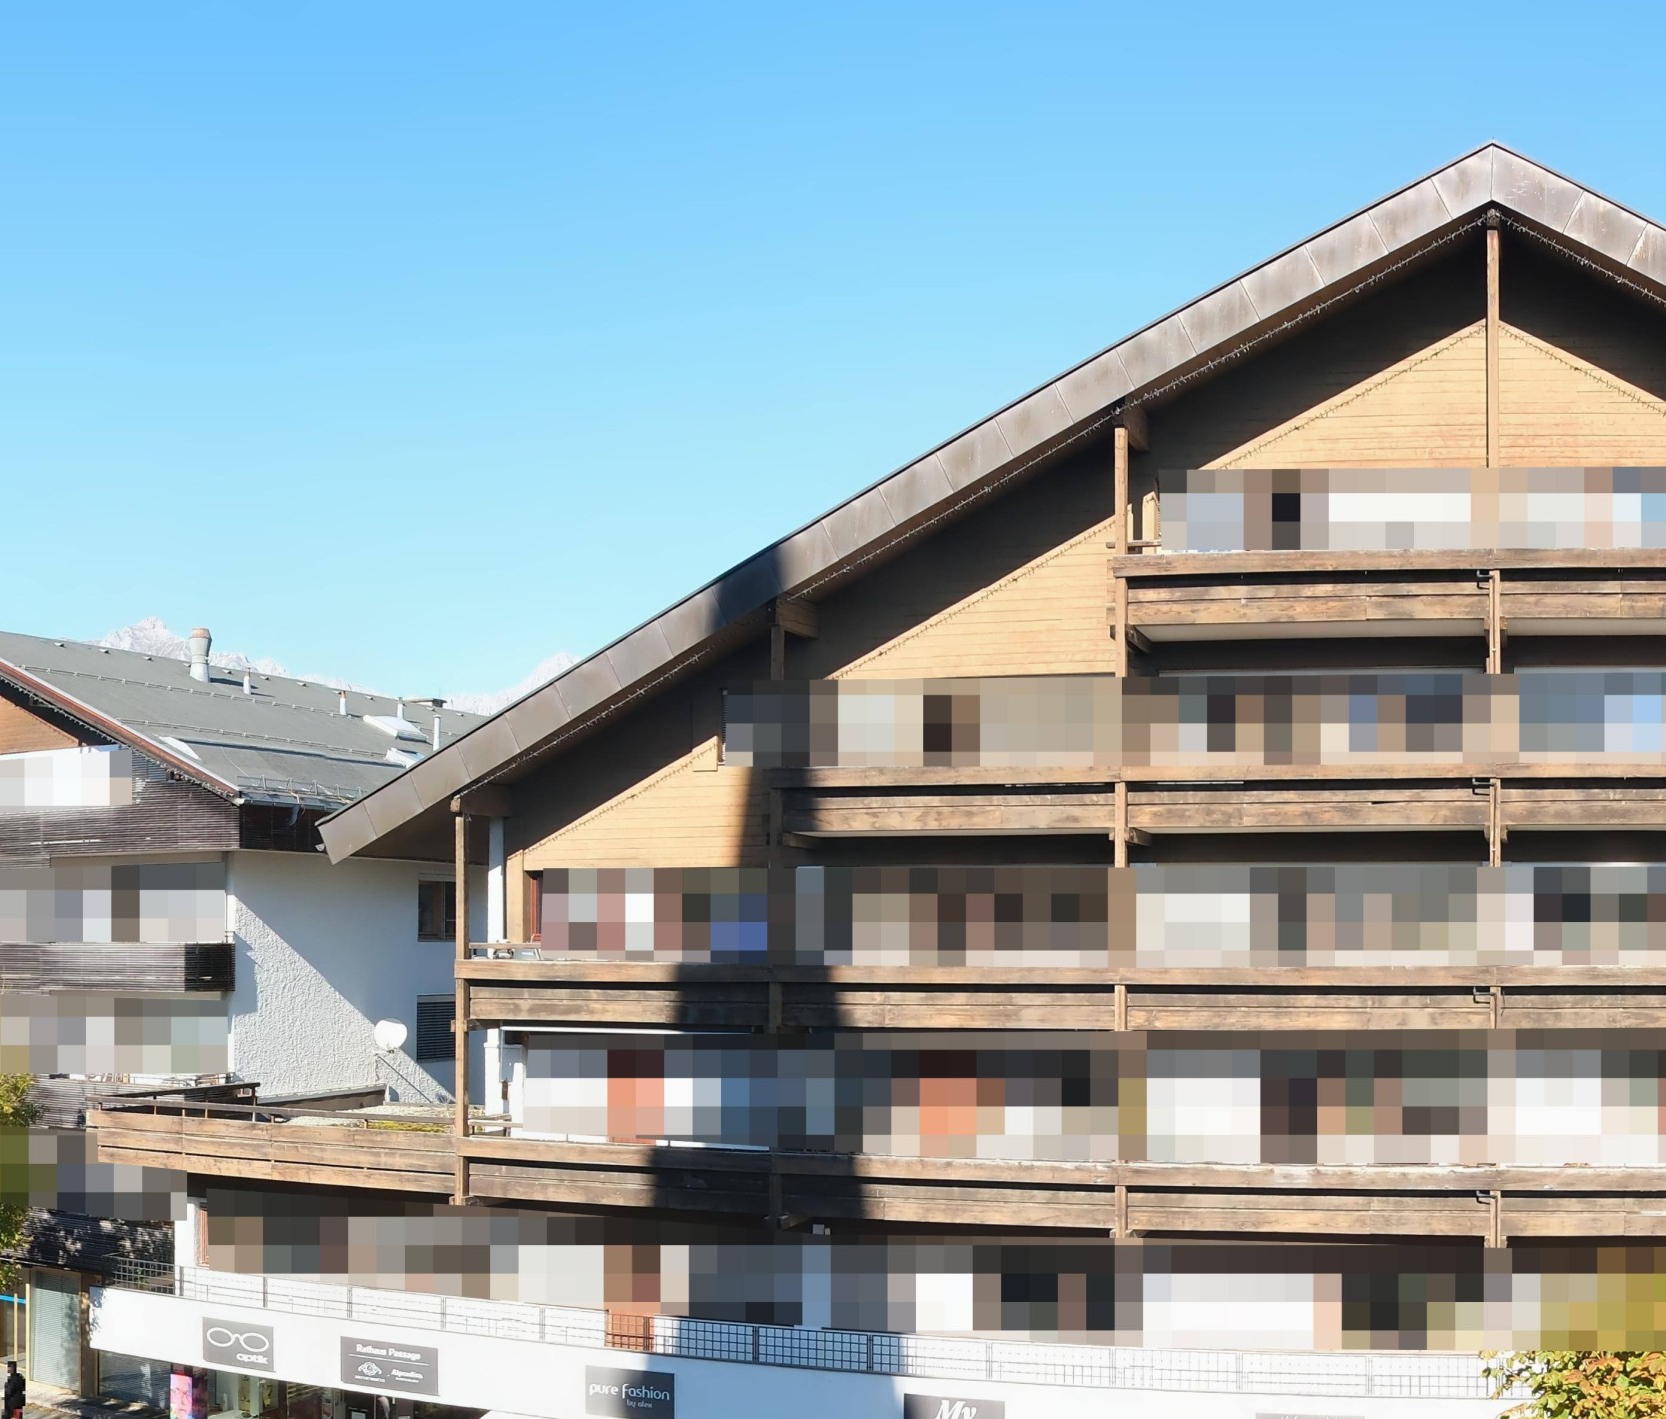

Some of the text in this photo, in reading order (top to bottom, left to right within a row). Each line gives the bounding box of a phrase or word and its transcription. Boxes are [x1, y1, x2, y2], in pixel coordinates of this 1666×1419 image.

[236, 1352, 270, 1365] optik
[588, 1383, 619, 1396] pure
[626, 1398, 636, 1408] by
